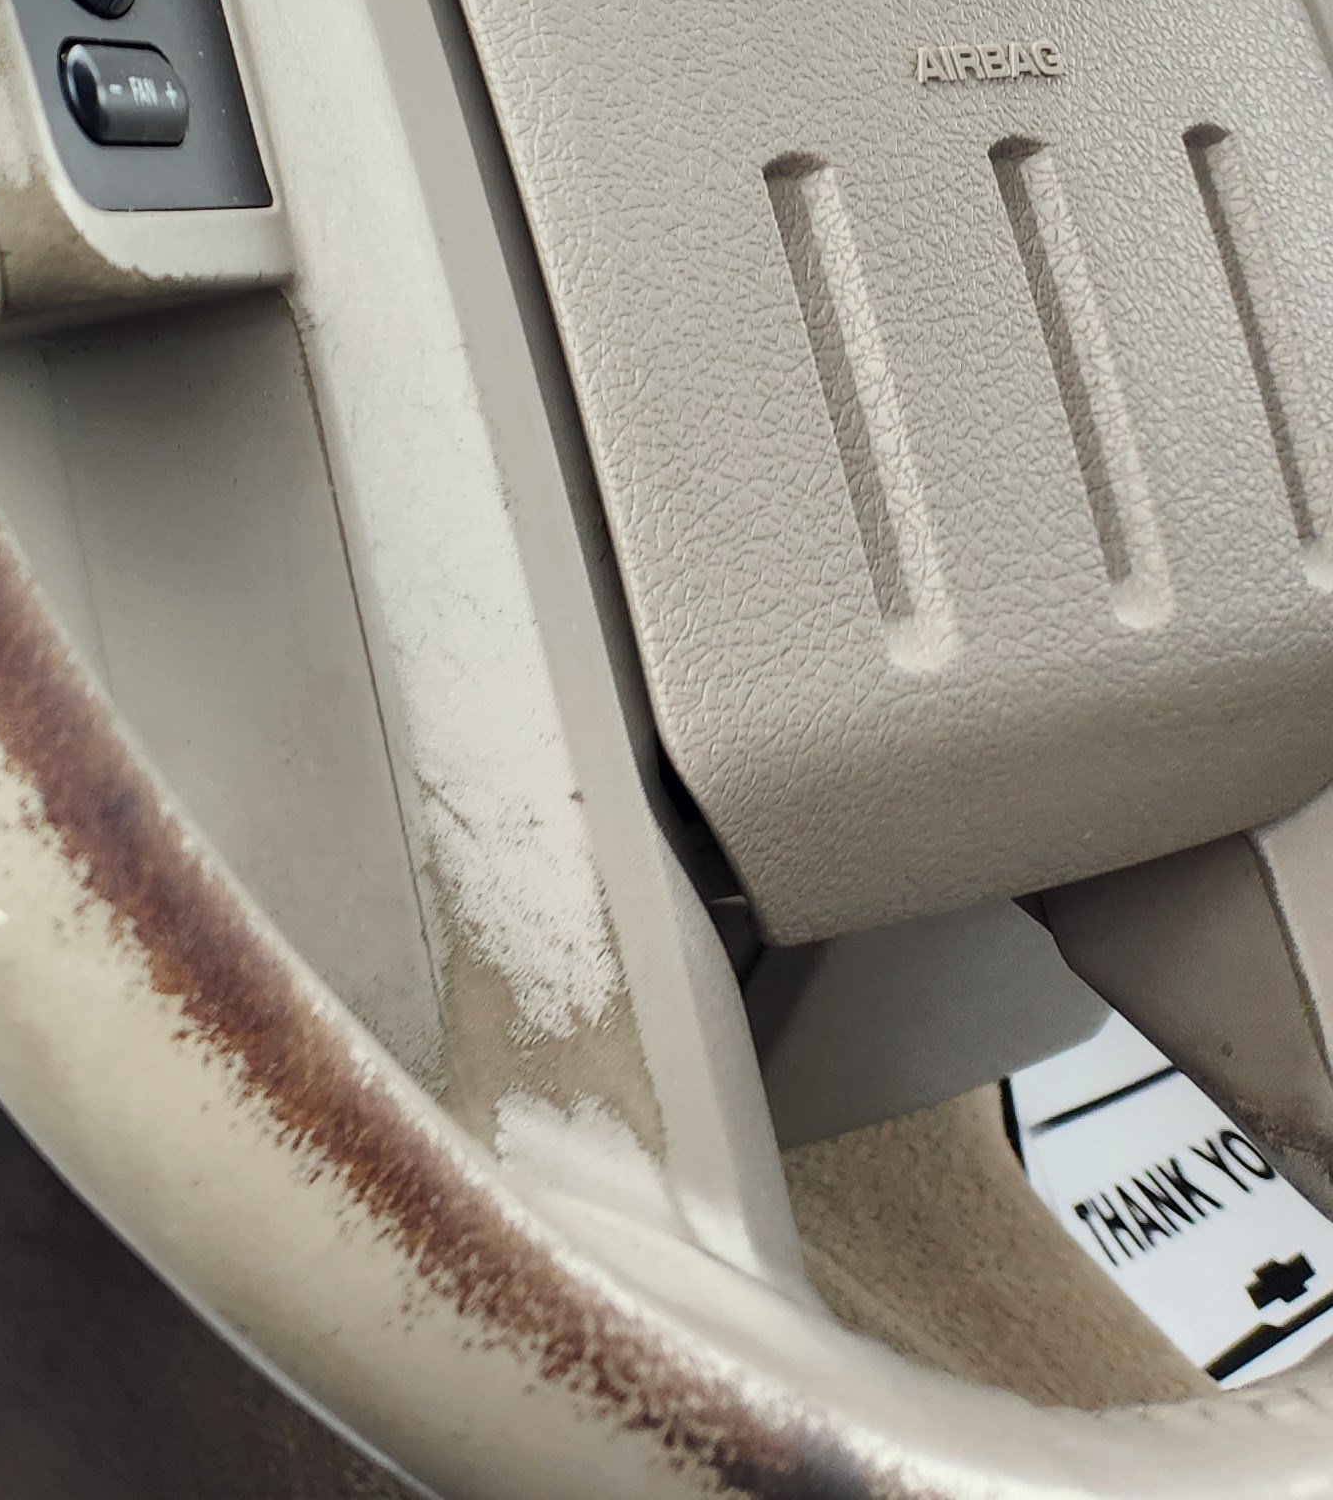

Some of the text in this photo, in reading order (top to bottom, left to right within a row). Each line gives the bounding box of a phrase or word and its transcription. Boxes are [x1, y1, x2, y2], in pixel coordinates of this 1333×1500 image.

[915, 40, 1065, 86] AIRBAG
[128, 75, 159, 108] FAN
[1074, 1156, 1225, 1268] THANK
